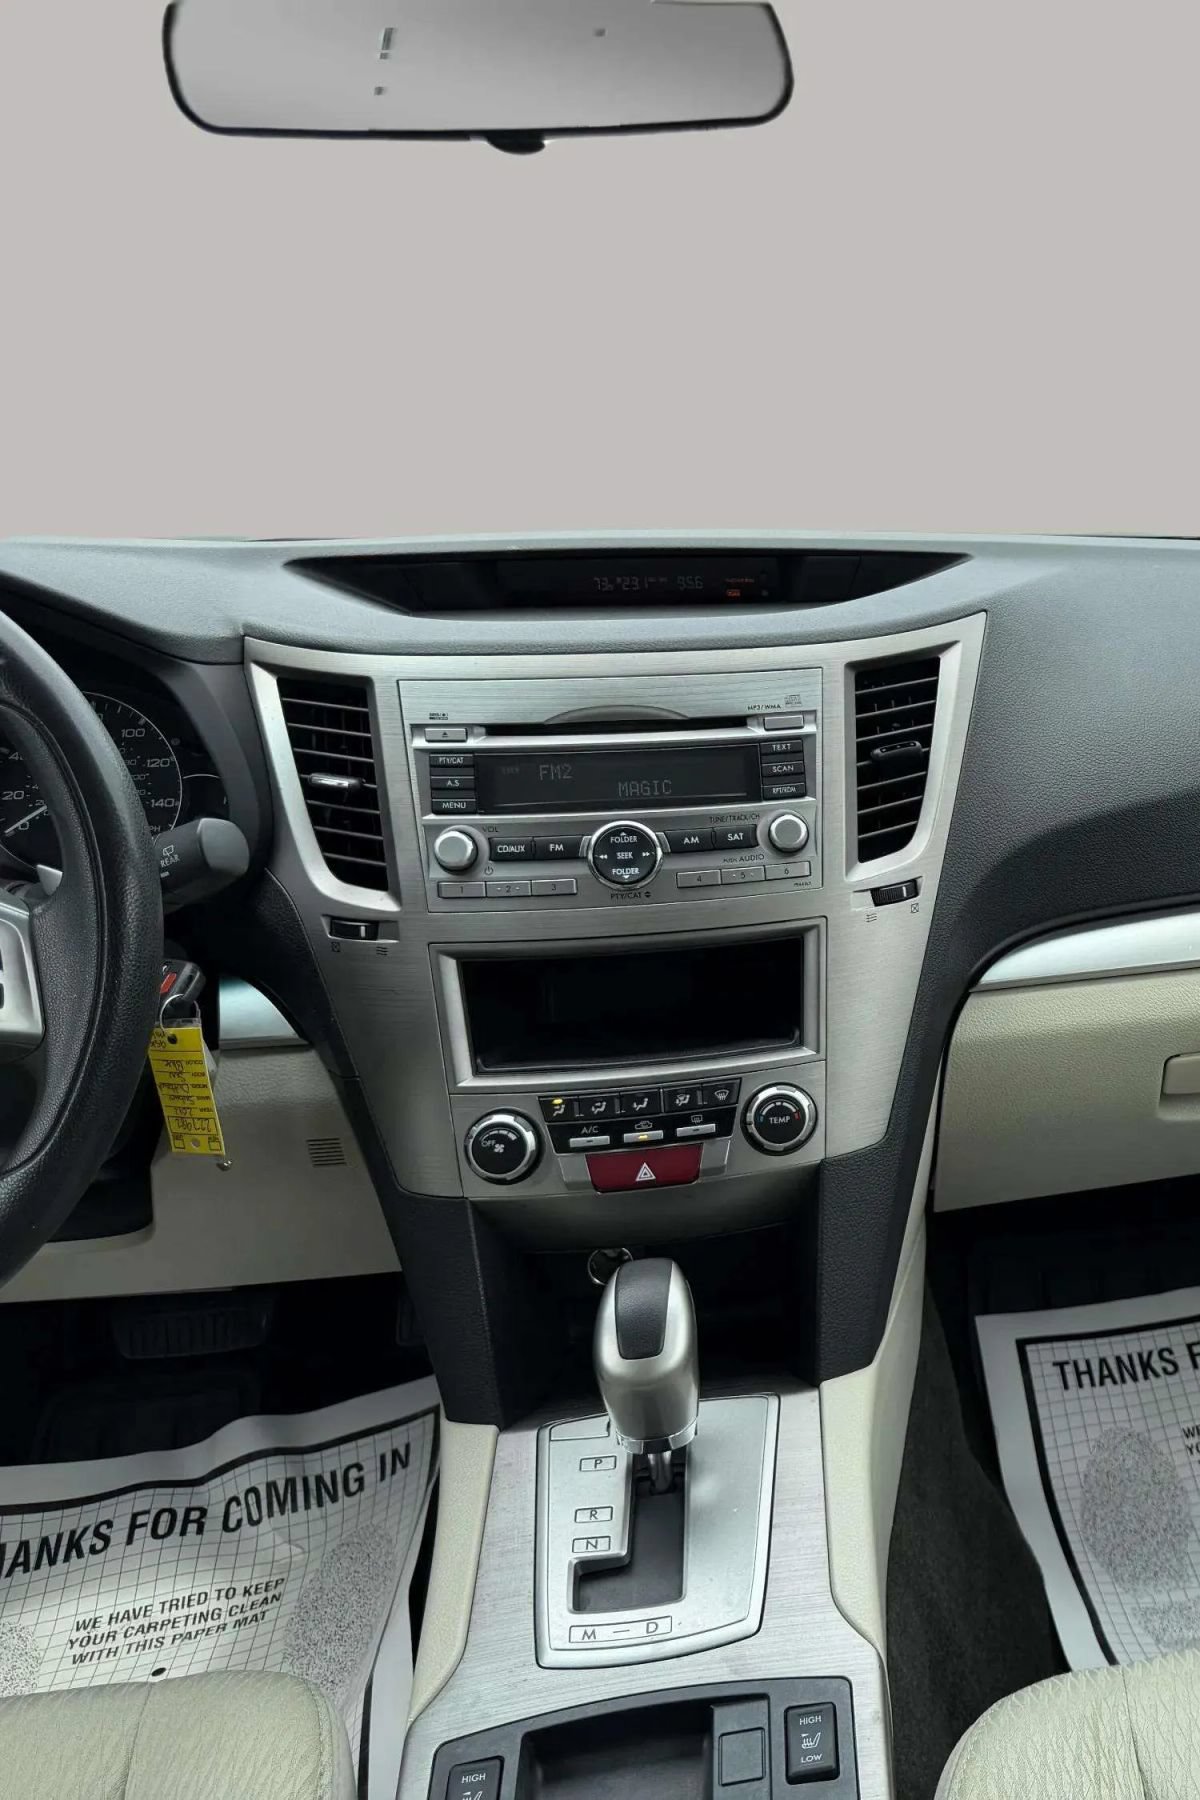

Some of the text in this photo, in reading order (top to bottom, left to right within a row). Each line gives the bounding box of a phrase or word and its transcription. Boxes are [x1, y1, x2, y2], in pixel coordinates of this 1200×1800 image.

[121, 728, 145, 738] 100
[772, 743, 791, 752] TEXT
[147, 758, 170, 768] 120
[539, 764, 574, 781] FM2
[772, 765, 794, 773] SCAN
[618, 779, 672, 797] MAGIC
[2, 790, 25, 800] 20
[151, 798, 175, 808] 140
[482, 824, 499, 833] VOL
[610, 833, 638, 844] FOLDER
[683, 836, 700, 844] AM
[727, 832, 744, 841] SAT
[497, 844, 526, 853] CD/AUX
[550, 844, 564, 852] FM
[160, 854, 180, 867] REAR
[616, 851, 634, 860] SEEK
[739, 853, 765, 862] AUDIO
[612, 866, 640, 875] FOLDER
[505, 886, 512, 894] 2
[768, 1115, 790, 1124] TEMP
[581, 1126, 600, 1134] A/C
[481, 1139, 496, 1148] OFF
[1052, 1347, 1179, 1391] THANKS
[593, 1458, 603, 1469] P
[126, 1506, 209, 1546] FOR
[222, 1462, 365, 1534] COMING
[379, 1442, 412, 1482] IN
[589, 1508, 598, 1520] R
[586, 1538, 599, 1550] N
[75, 1577, 286, 1633] WE HAVE TRIED TO KEEP
[69, 1592, 282, 1650] YOUR CARPETING CLEAN
[72, 1609, 270, 1666] WITH THIS PAPER MAT
[799, 1715, 822, 1726] HIGH
[800, 1754, 823, 1764] LOW
[461, 1772, 486, 1784] HIGH
